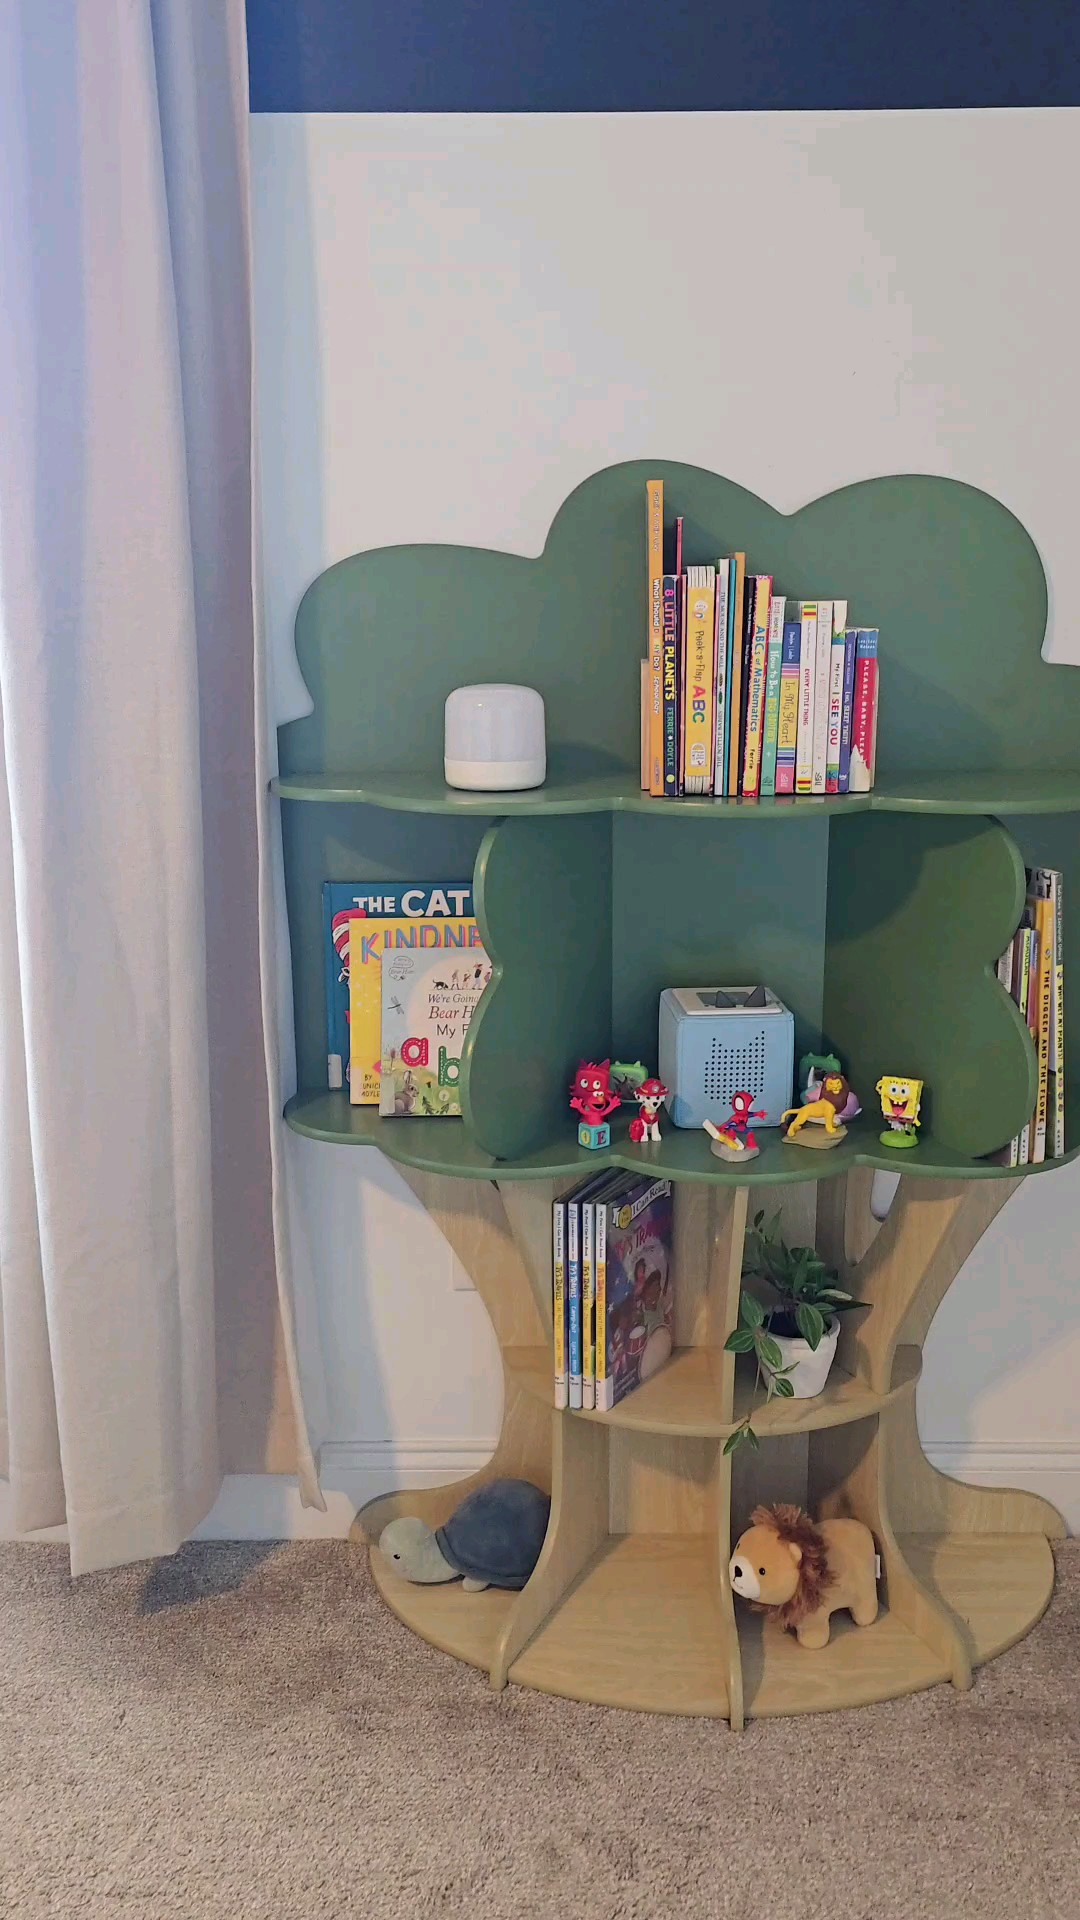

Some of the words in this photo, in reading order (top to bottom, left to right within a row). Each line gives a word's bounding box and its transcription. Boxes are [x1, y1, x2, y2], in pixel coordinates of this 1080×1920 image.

[664, 588, 674, 597] 8
[664, 602, 676, 642] LITTLE
[754, 626, 764, 656] ABCs
[769, 651, 779, 668] How
[834, 664, 840, 672] My
[664, 646, 676, 700] PLANETS
[769, 680, 777, 691] Be
[786, 682, 795, 690] In
[692, 685, 706, 724] ABC
[750, 668, 762, 732] Mathematics
[782, 694, 794, 710] My
[831, 699, 839, 718] SEE
[782, 712, 794, 744] Heart
[830, 721, 838, 745] YOU
[352, 896, 395, 913] THE
[401, 889, 470, 917] CAT
[428, 994, 450, 1003] We're
[428, 1006, 459, 1019] Bear
[437, 1024, 456, 1038] My
[401, 1037, 428, 1067] a
[438, 1046, 460, 1088] b
[596, 1130, 606, 1146] E
[636, 1195, 648, 1211] Can
